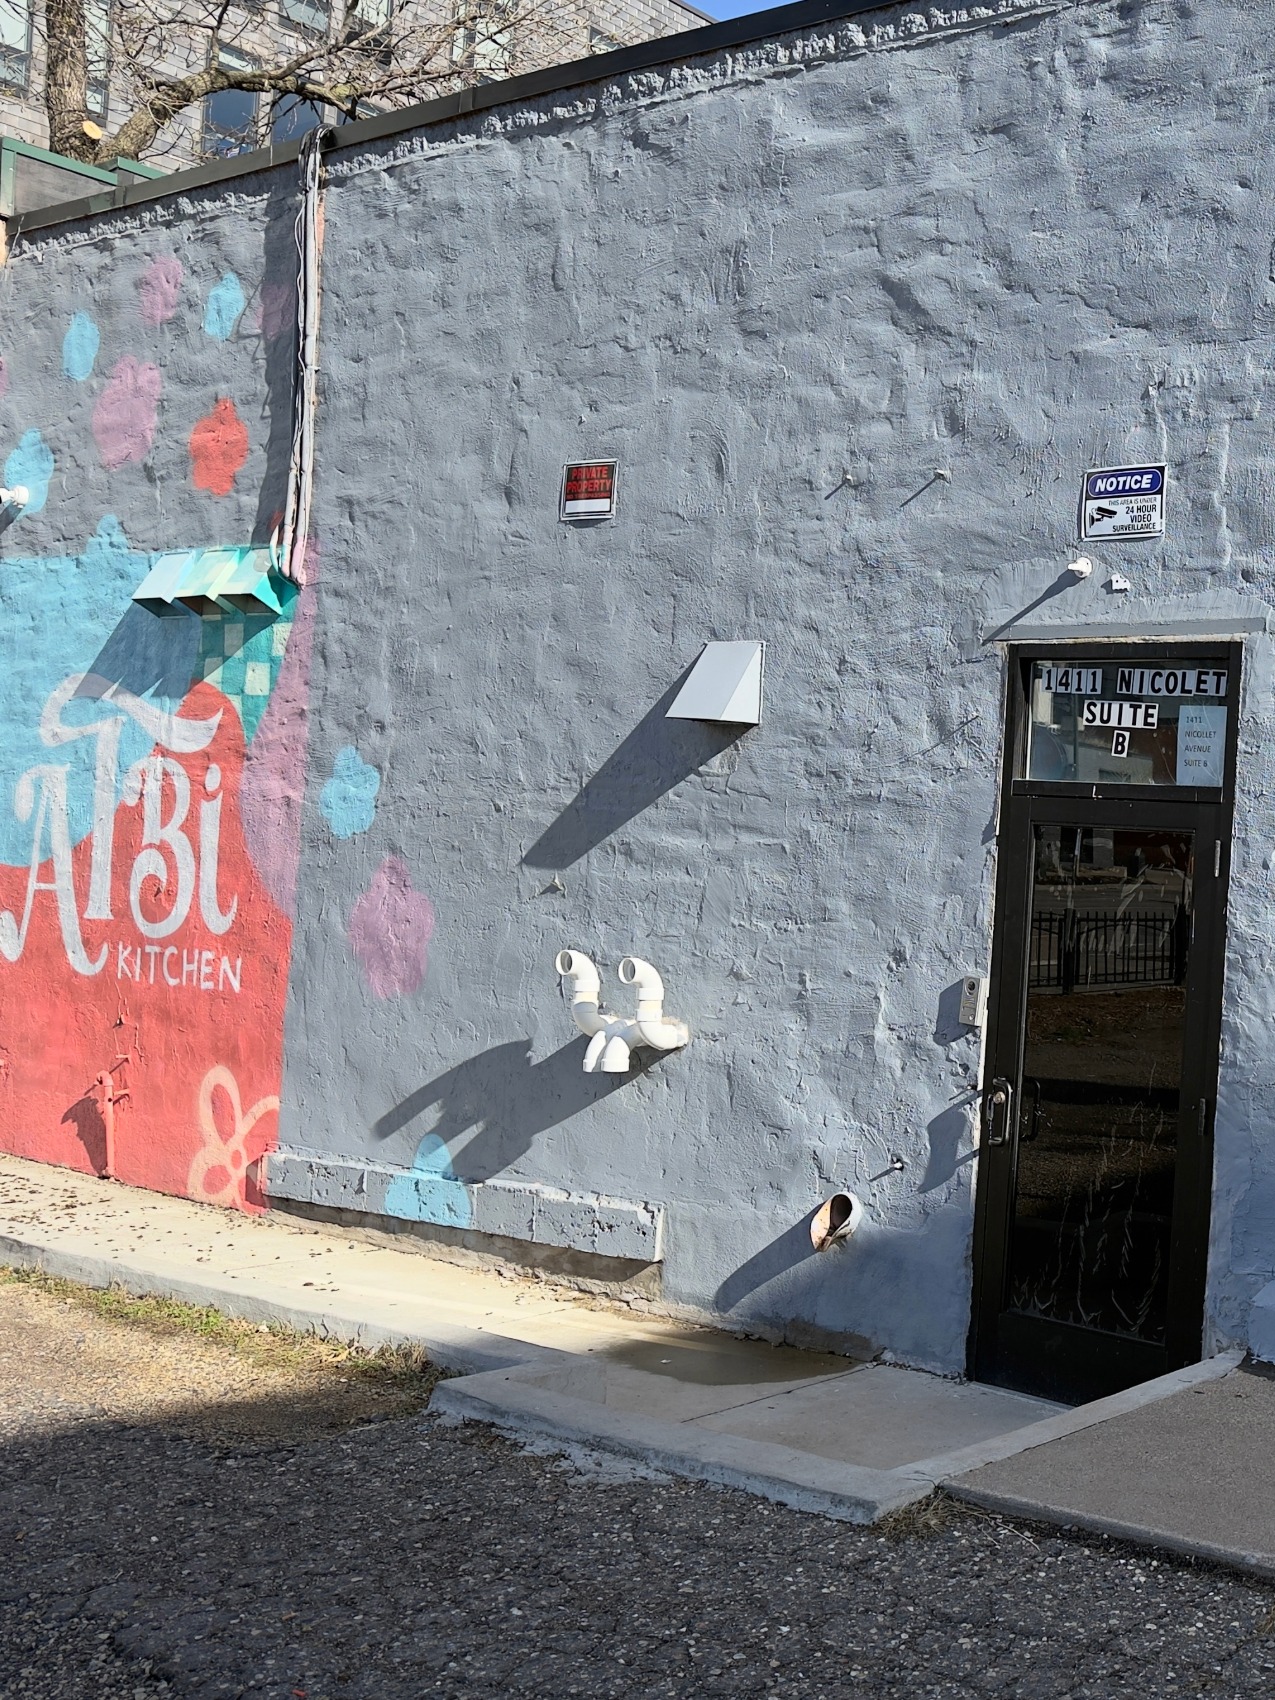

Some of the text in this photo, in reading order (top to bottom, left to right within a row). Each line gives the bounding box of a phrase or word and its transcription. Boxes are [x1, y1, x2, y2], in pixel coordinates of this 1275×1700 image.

[572, 466, 609, 479] PRIVATE
[567, 479, 612, 493] PROPERTY
[1095, 474, 1153, 492] NOTICE
[1125, 504, 1157, 514] 24 HOUR
[1130, 514, 1152, 523] VIDEO
[1112, 522, 1156, 532] SURVEILLANCE
[1044, 669, 1227, 694] 1411 NICOLET
[1085, 701, 1158, 727] SUITE
[1186, 716, 1202, 724] 1411
[1184, 730, 1217, 738] NICOLLET
[1113, 732, 1127, 755] B
[1184, 745, 1211, 753] AVENUE
[1184, 759, 1201, 767] SUITE
[117, 940, 243, 994] KITCHEN
